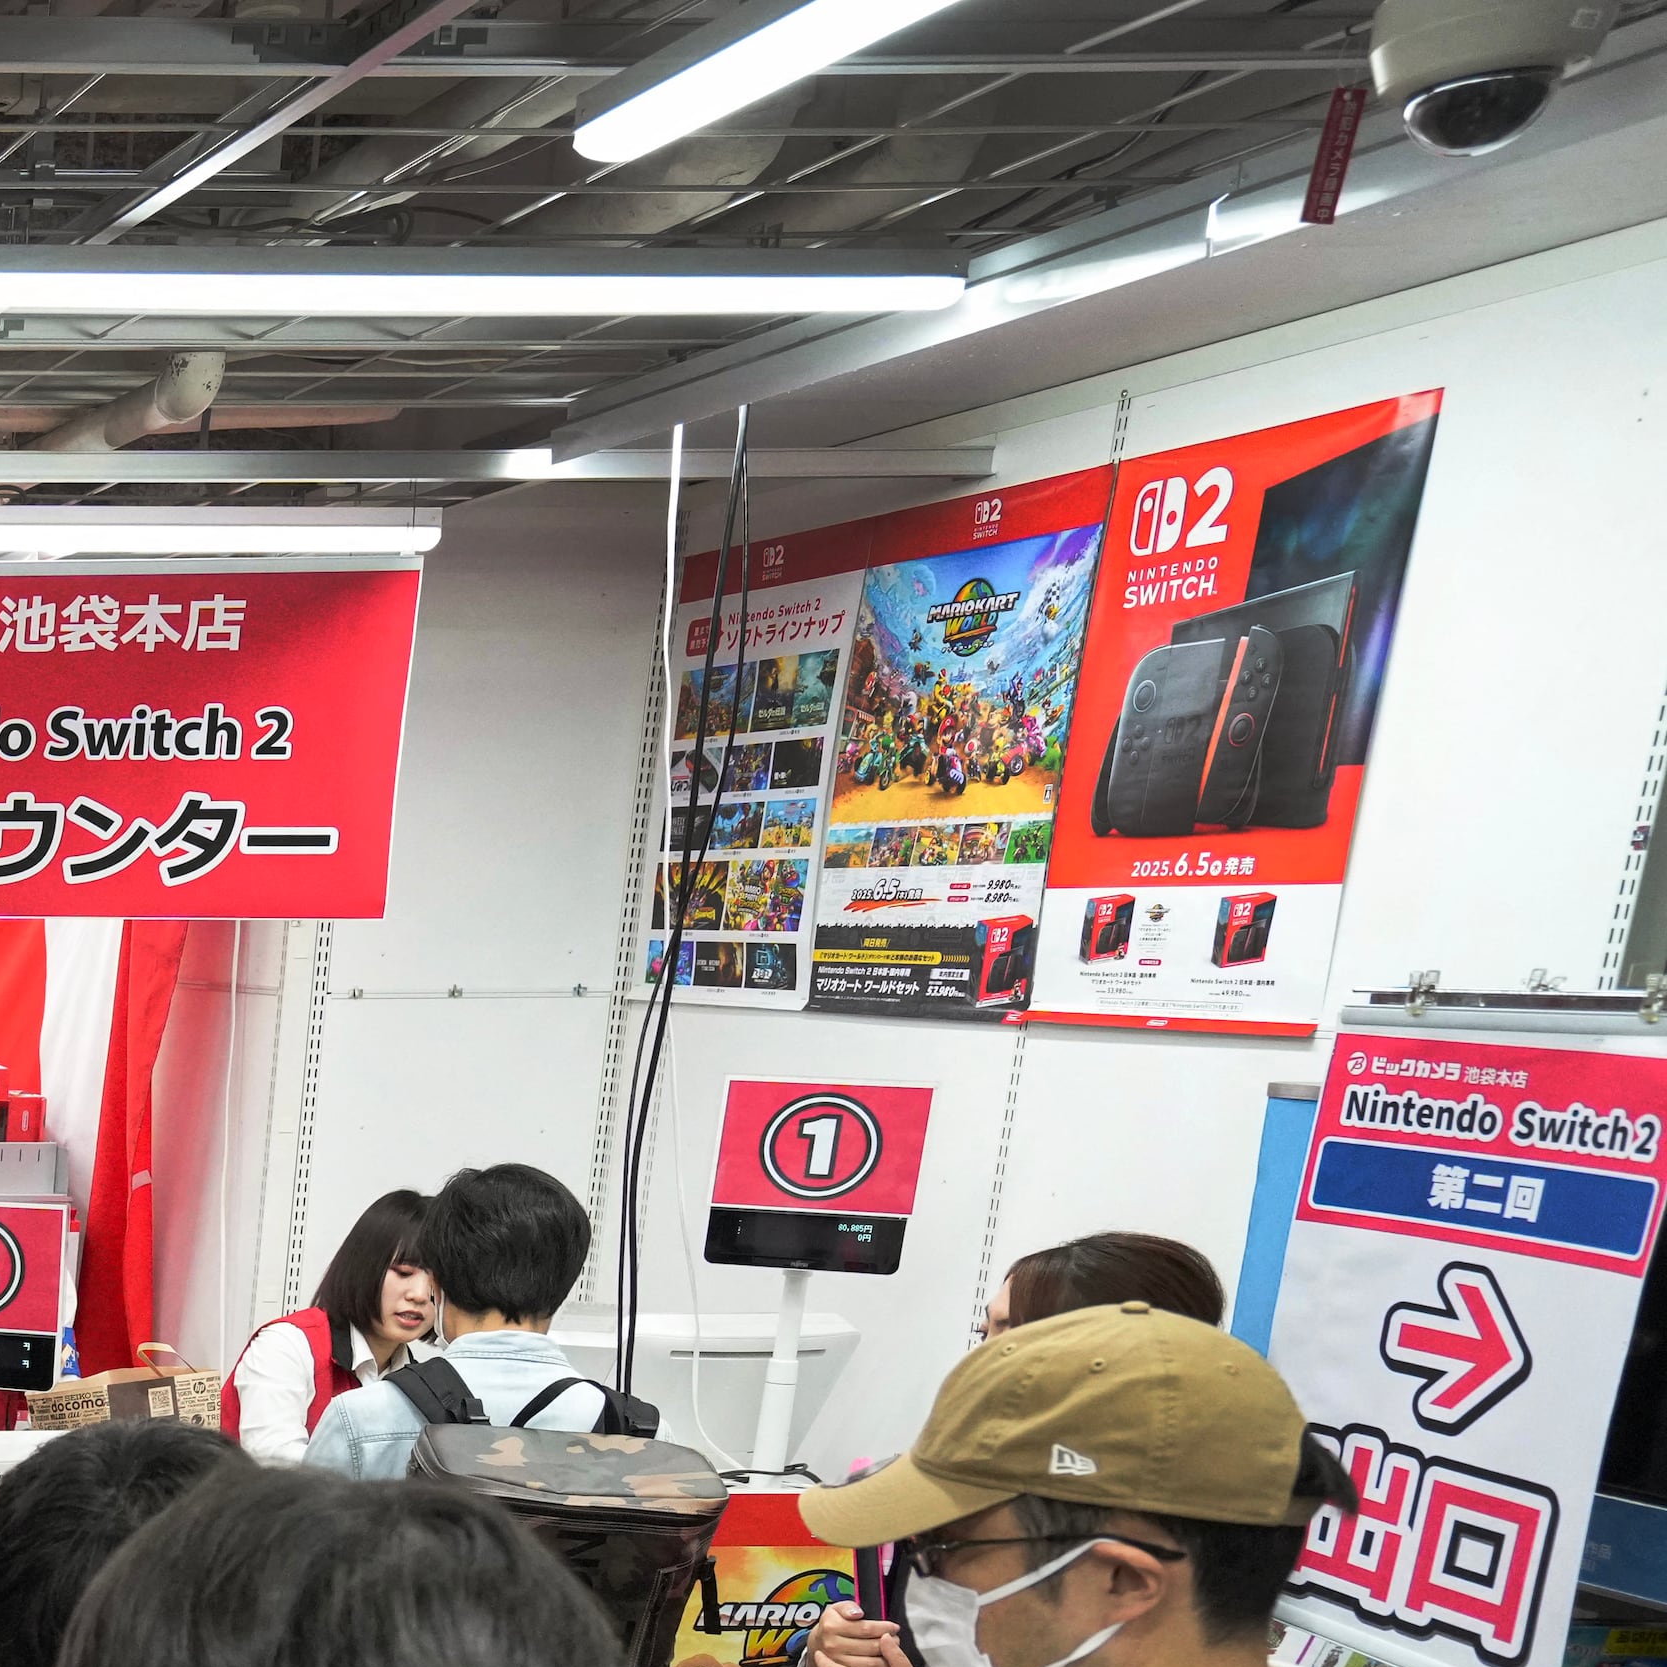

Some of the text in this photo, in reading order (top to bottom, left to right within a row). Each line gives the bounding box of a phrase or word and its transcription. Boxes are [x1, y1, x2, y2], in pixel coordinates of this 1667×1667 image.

[972, 529, 998, 540] SWITCH
[1127, 556, 1218, 583] NINTENDO
[1123, 573, 1216, 609] SWITCH
[728, 598, 821, 626] Nitendo Switch 2
[945, 611, 999, 637] WORLD
[48, 706, 240, 760] Switch
[255, 707, 294, 760] 2
[817, 966, 844, 975] Nintendo
[845, 966, 866, 975] Switch
[816, 977, 920, 996] マリオカート ワールドセット
[1370, 1056, 1462, 1081] ビックカメラ
[1464, 1065, 1530, 1089] 池袋本店
[1345, 1088, 1658, 1155] Nintendo Switch 2
[1427, 1163, 1546, 1224] 第二回
[51, 1397, 104, 1414] docomo
[64, 1392, 91, 1402] SEIKO
[1295, 1443, 1542, 1645] 出口
